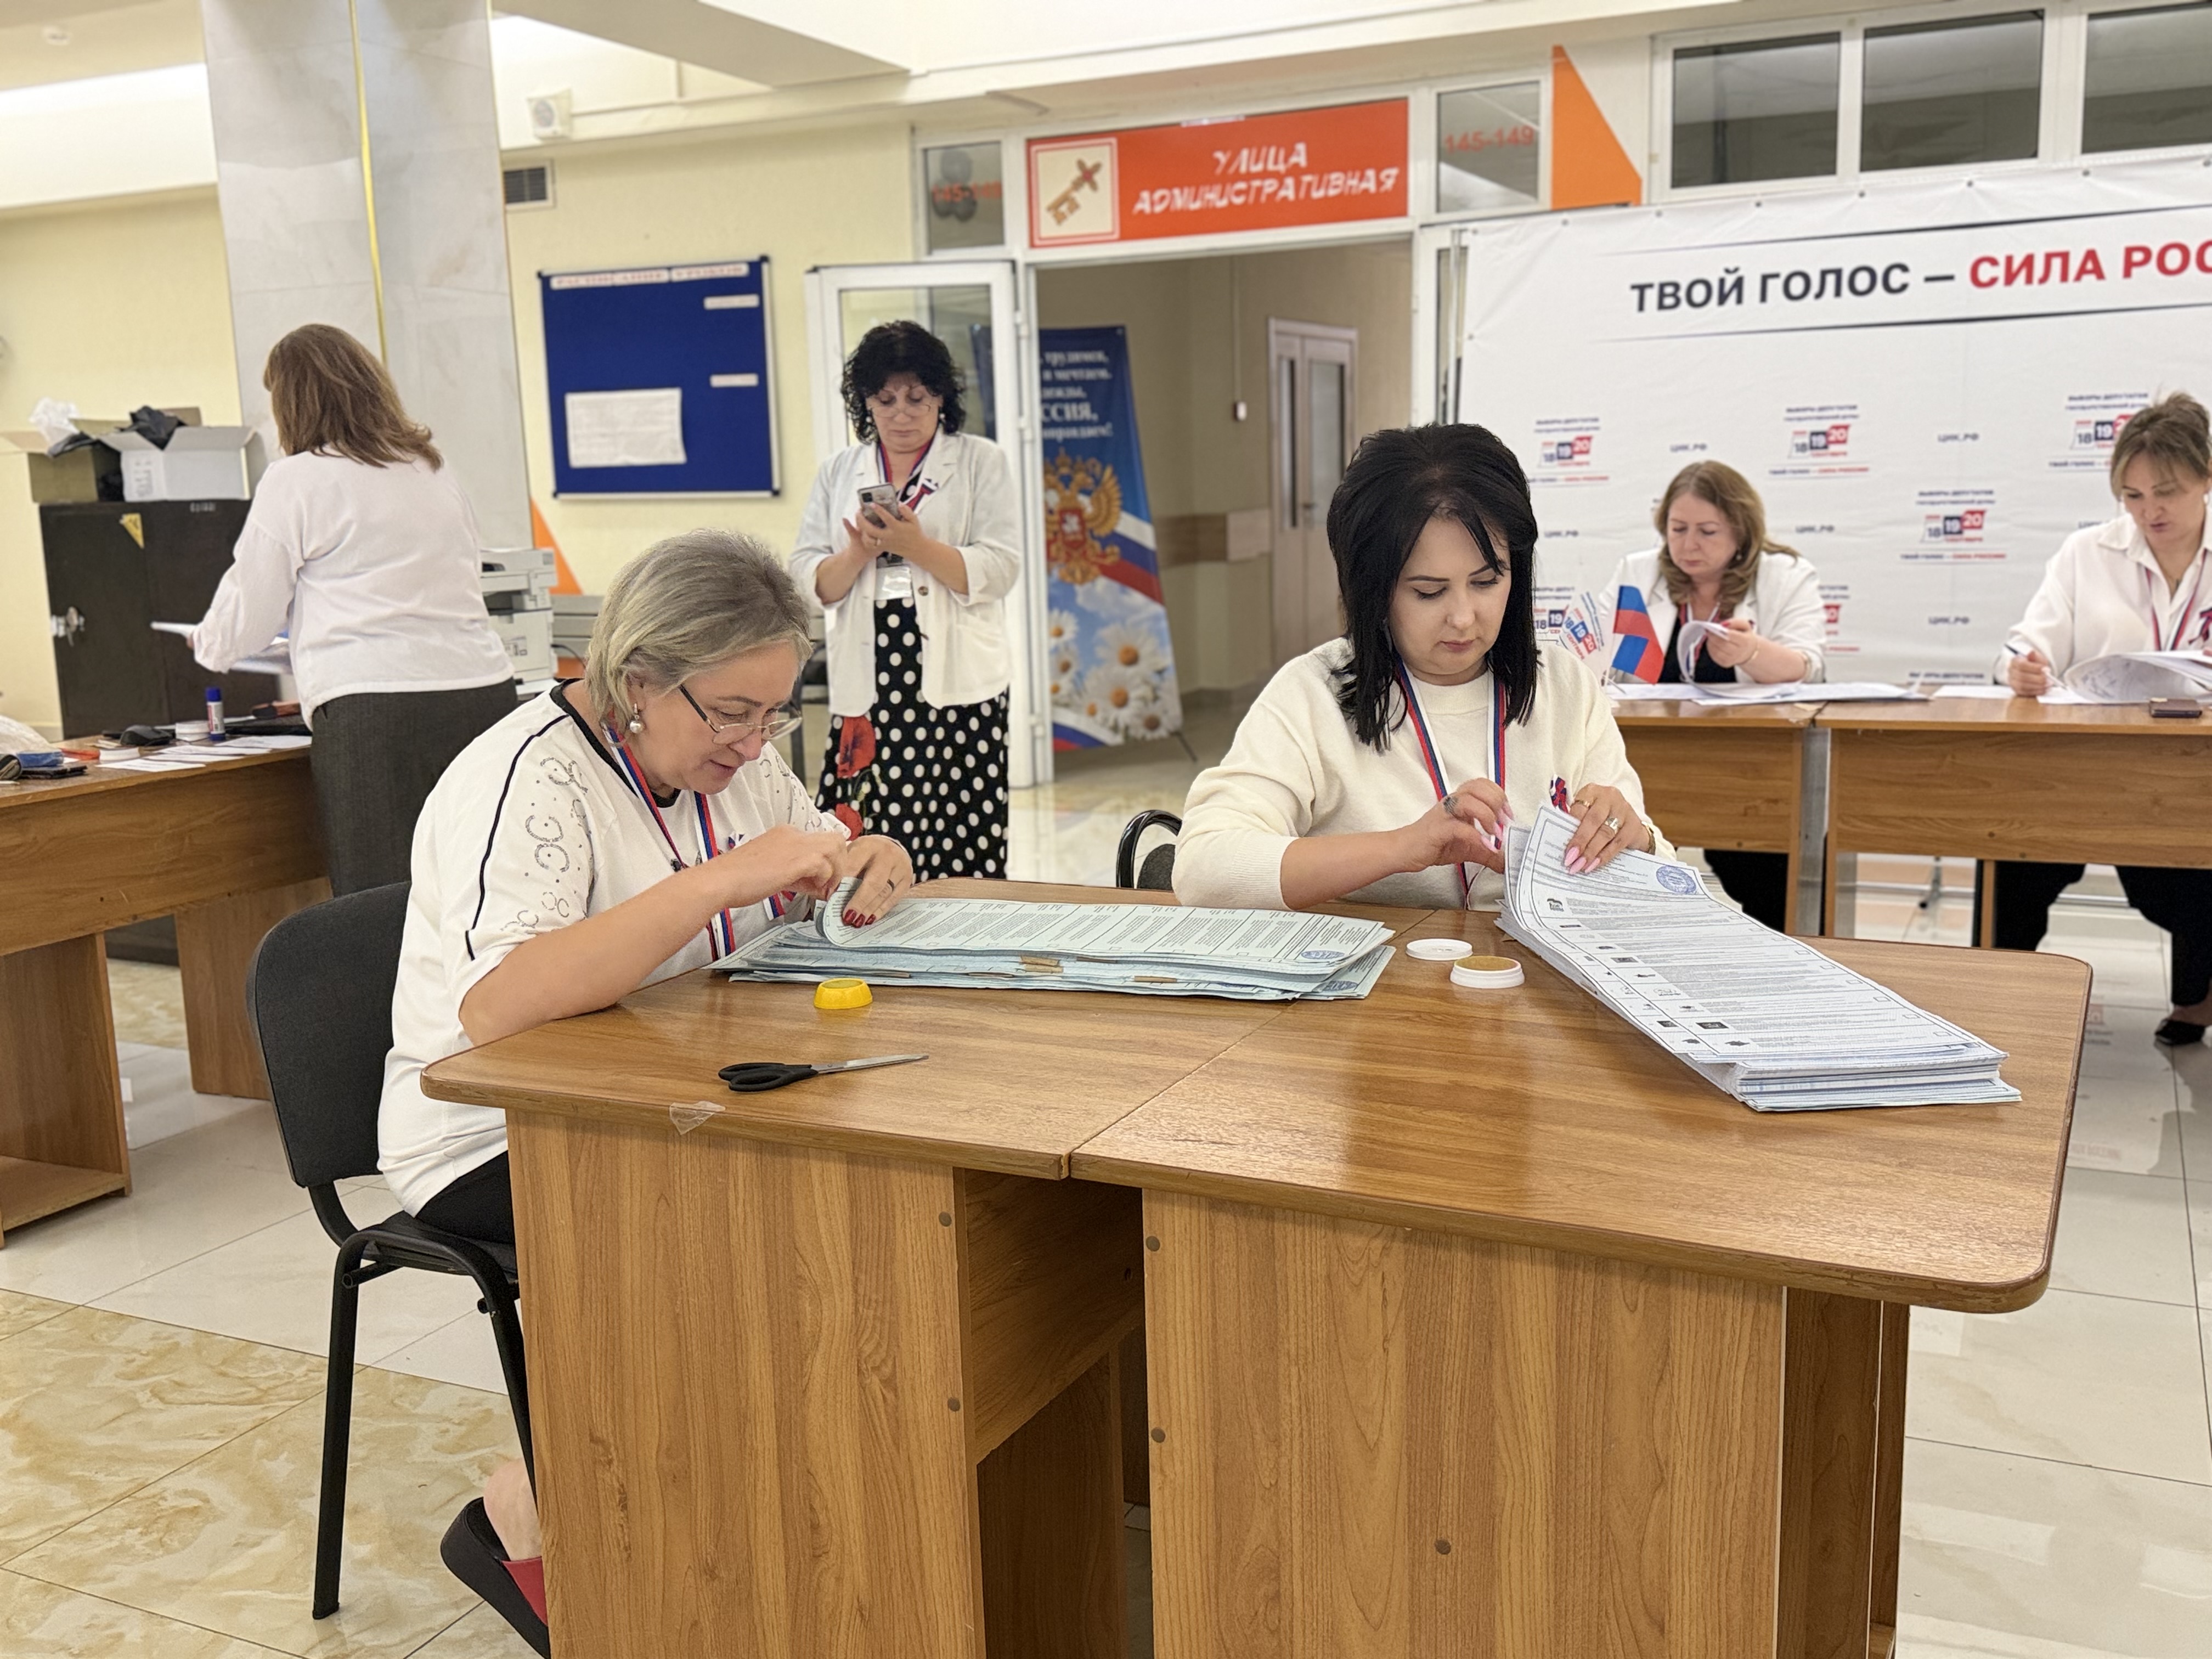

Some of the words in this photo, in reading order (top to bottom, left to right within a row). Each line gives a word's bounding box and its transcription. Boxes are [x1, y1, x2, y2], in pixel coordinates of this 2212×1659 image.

[1445, 124, 1534, 154] 145-149
[1212, 142, 1308, 174] УЛИЦА
[1132, 167, 1399, 215] АДМИНИСТРАТИВНАЯ
[1630, 267, 1745, 313] ТВОЙ
[1759, 262, 1911, 303] ГОЛОС
[1970, 249, 2106, 289] СИЛА
[1041, 401, 1099, 422] ССИЯ,
[2114, 418, 2126, 432] 2
[1927, 527, 1942, 537] 18
[1945, 518, 1961, 533] 19
[1962, 513, 1982, 527] 20
[1549, 613, 1563, 625] 19
[1565, 617, 1575, 629] 18
[1575, 624, 1586, 638] 19
[1584, 636, 1594, 649] 20
